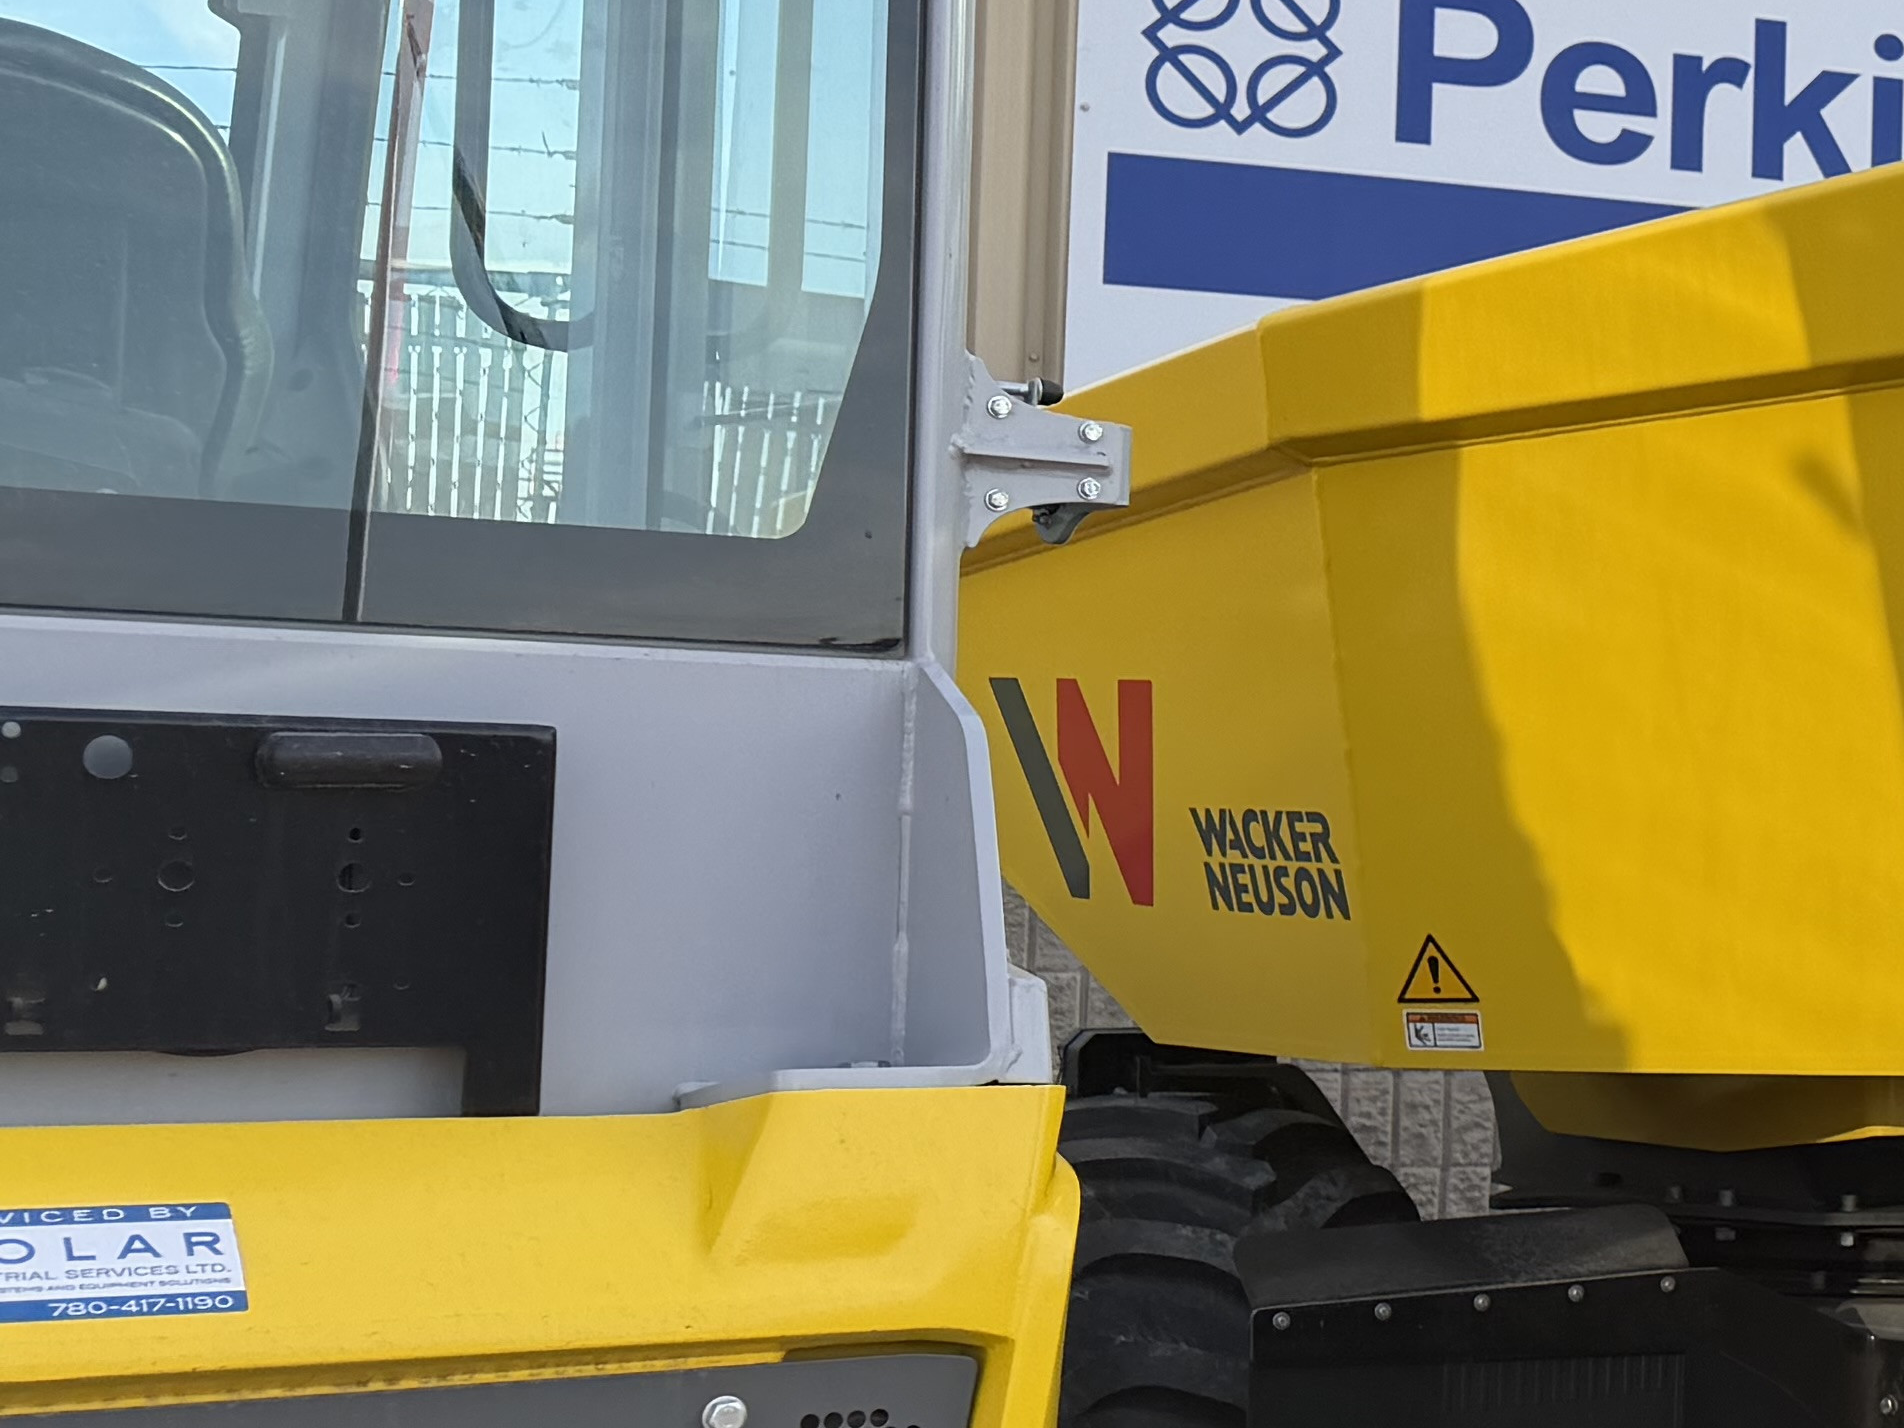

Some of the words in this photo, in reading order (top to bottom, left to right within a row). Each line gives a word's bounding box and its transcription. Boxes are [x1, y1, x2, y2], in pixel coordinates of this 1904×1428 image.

[1189, 807, 1341, 865] WACKER
[1203, 862, 1352, 922] NEUSON
[149, 1205, 198, 1219] BY
[65, 1265, 181, 1280] SERVICES
[185, 1263, 232, 1274] LTD.
[48, 1295, 234, 1316] 780-417-1190
